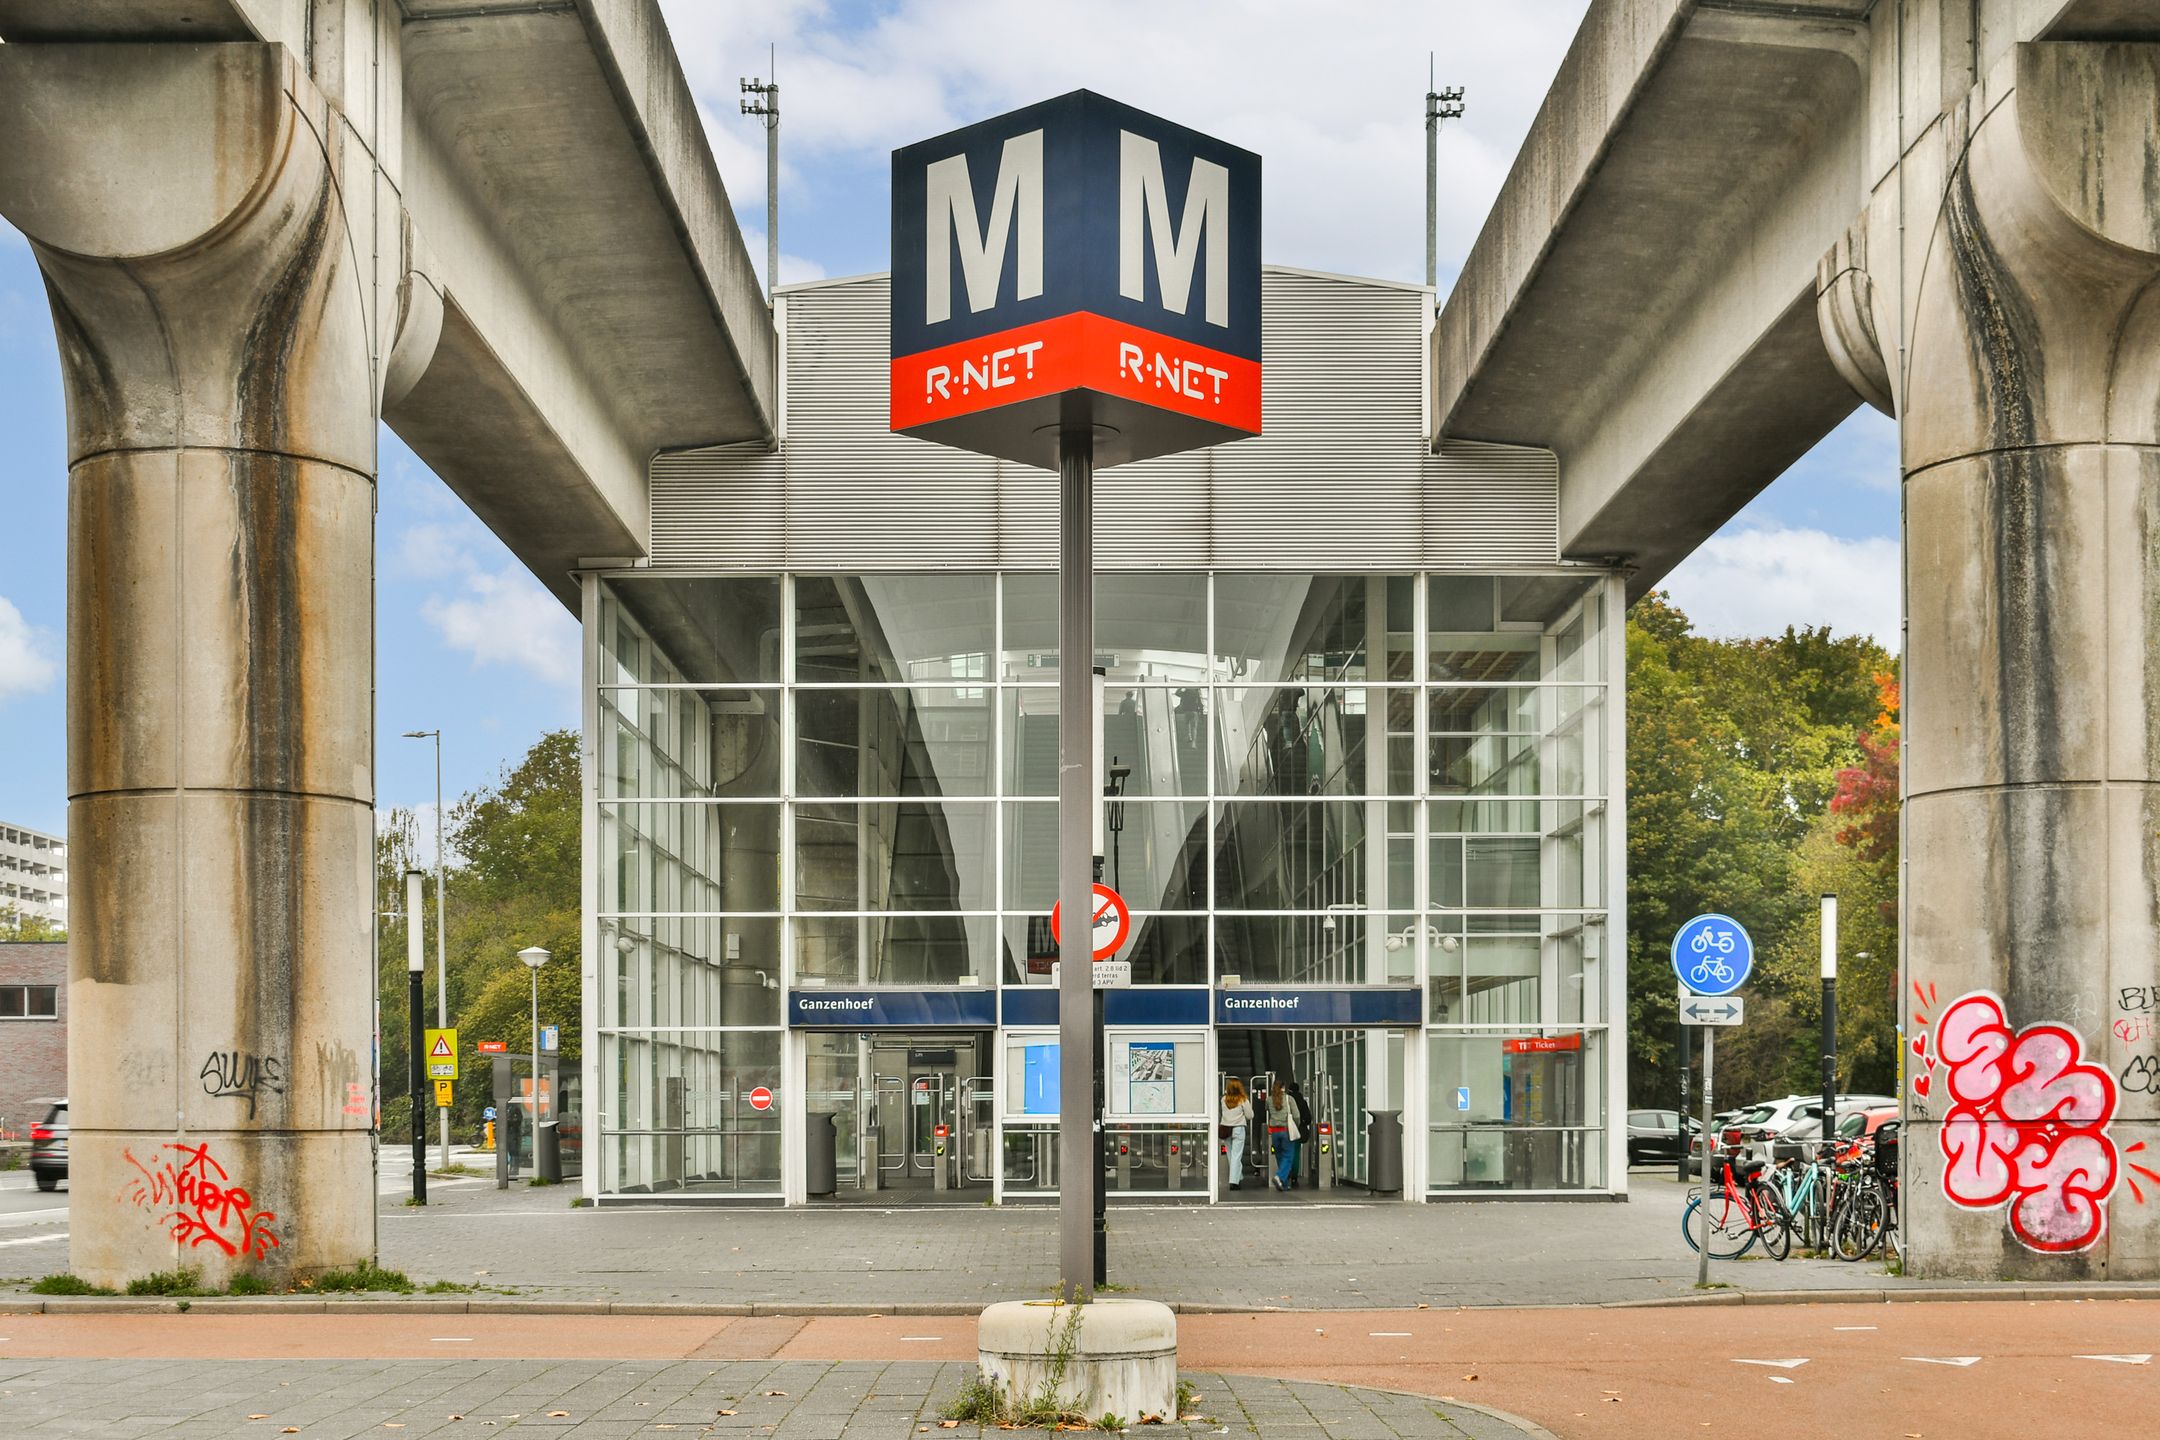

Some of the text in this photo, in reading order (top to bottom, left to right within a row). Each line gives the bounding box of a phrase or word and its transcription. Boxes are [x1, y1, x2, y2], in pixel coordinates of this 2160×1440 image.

[926, 128, 1044, 326] M
[1119, 129, 1229, 328] M
[799, 998, 874, 1010] Ganzenhoef
[1224, 997, 1299, 1009] Ganzenhoef
[439, 1082, 448, 1092] P
